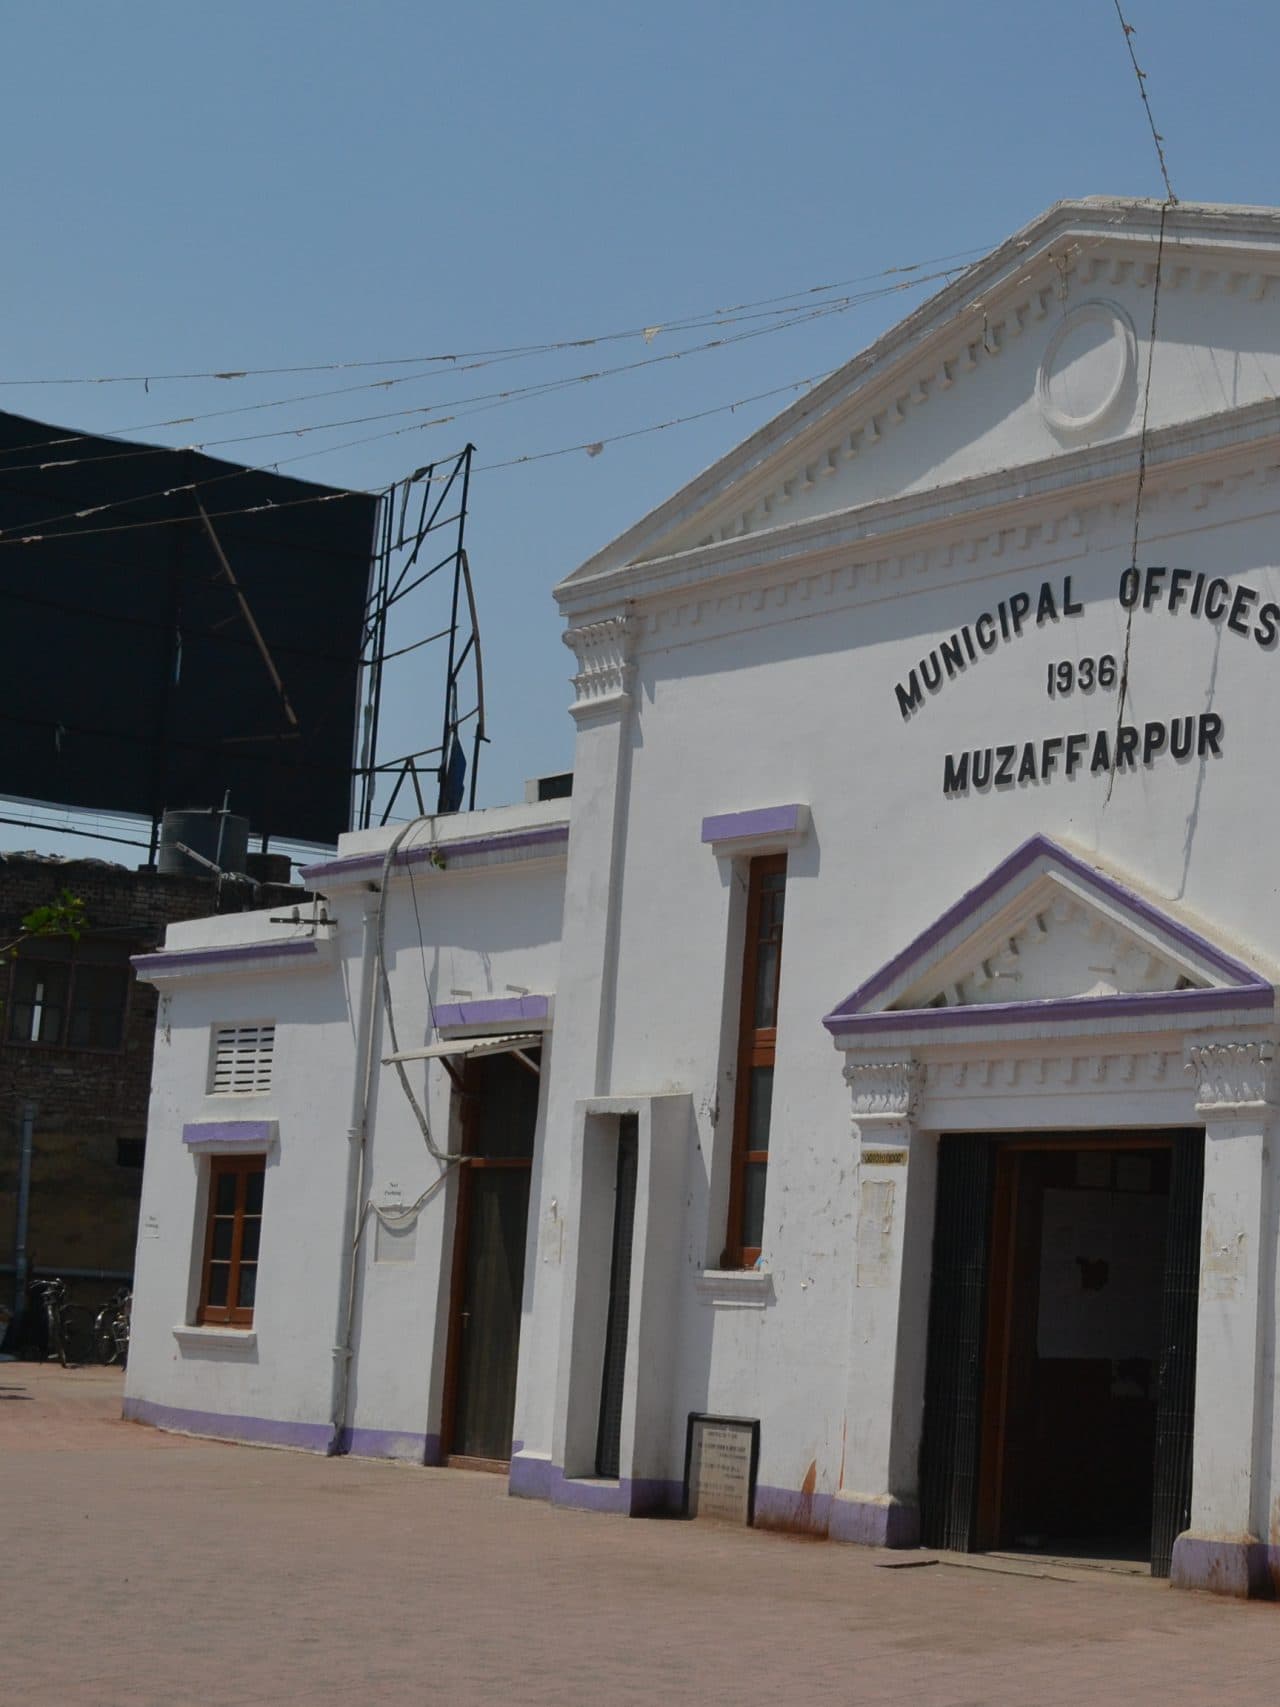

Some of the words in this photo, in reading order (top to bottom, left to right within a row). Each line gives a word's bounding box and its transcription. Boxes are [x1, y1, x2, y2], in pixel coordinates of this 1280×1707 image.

[894, 575, 1084, 718] MUNICIPAL
[1047, 654, 1116, 695] 1936
[943, 713, 1222, 793] MUZAFFARPUR
